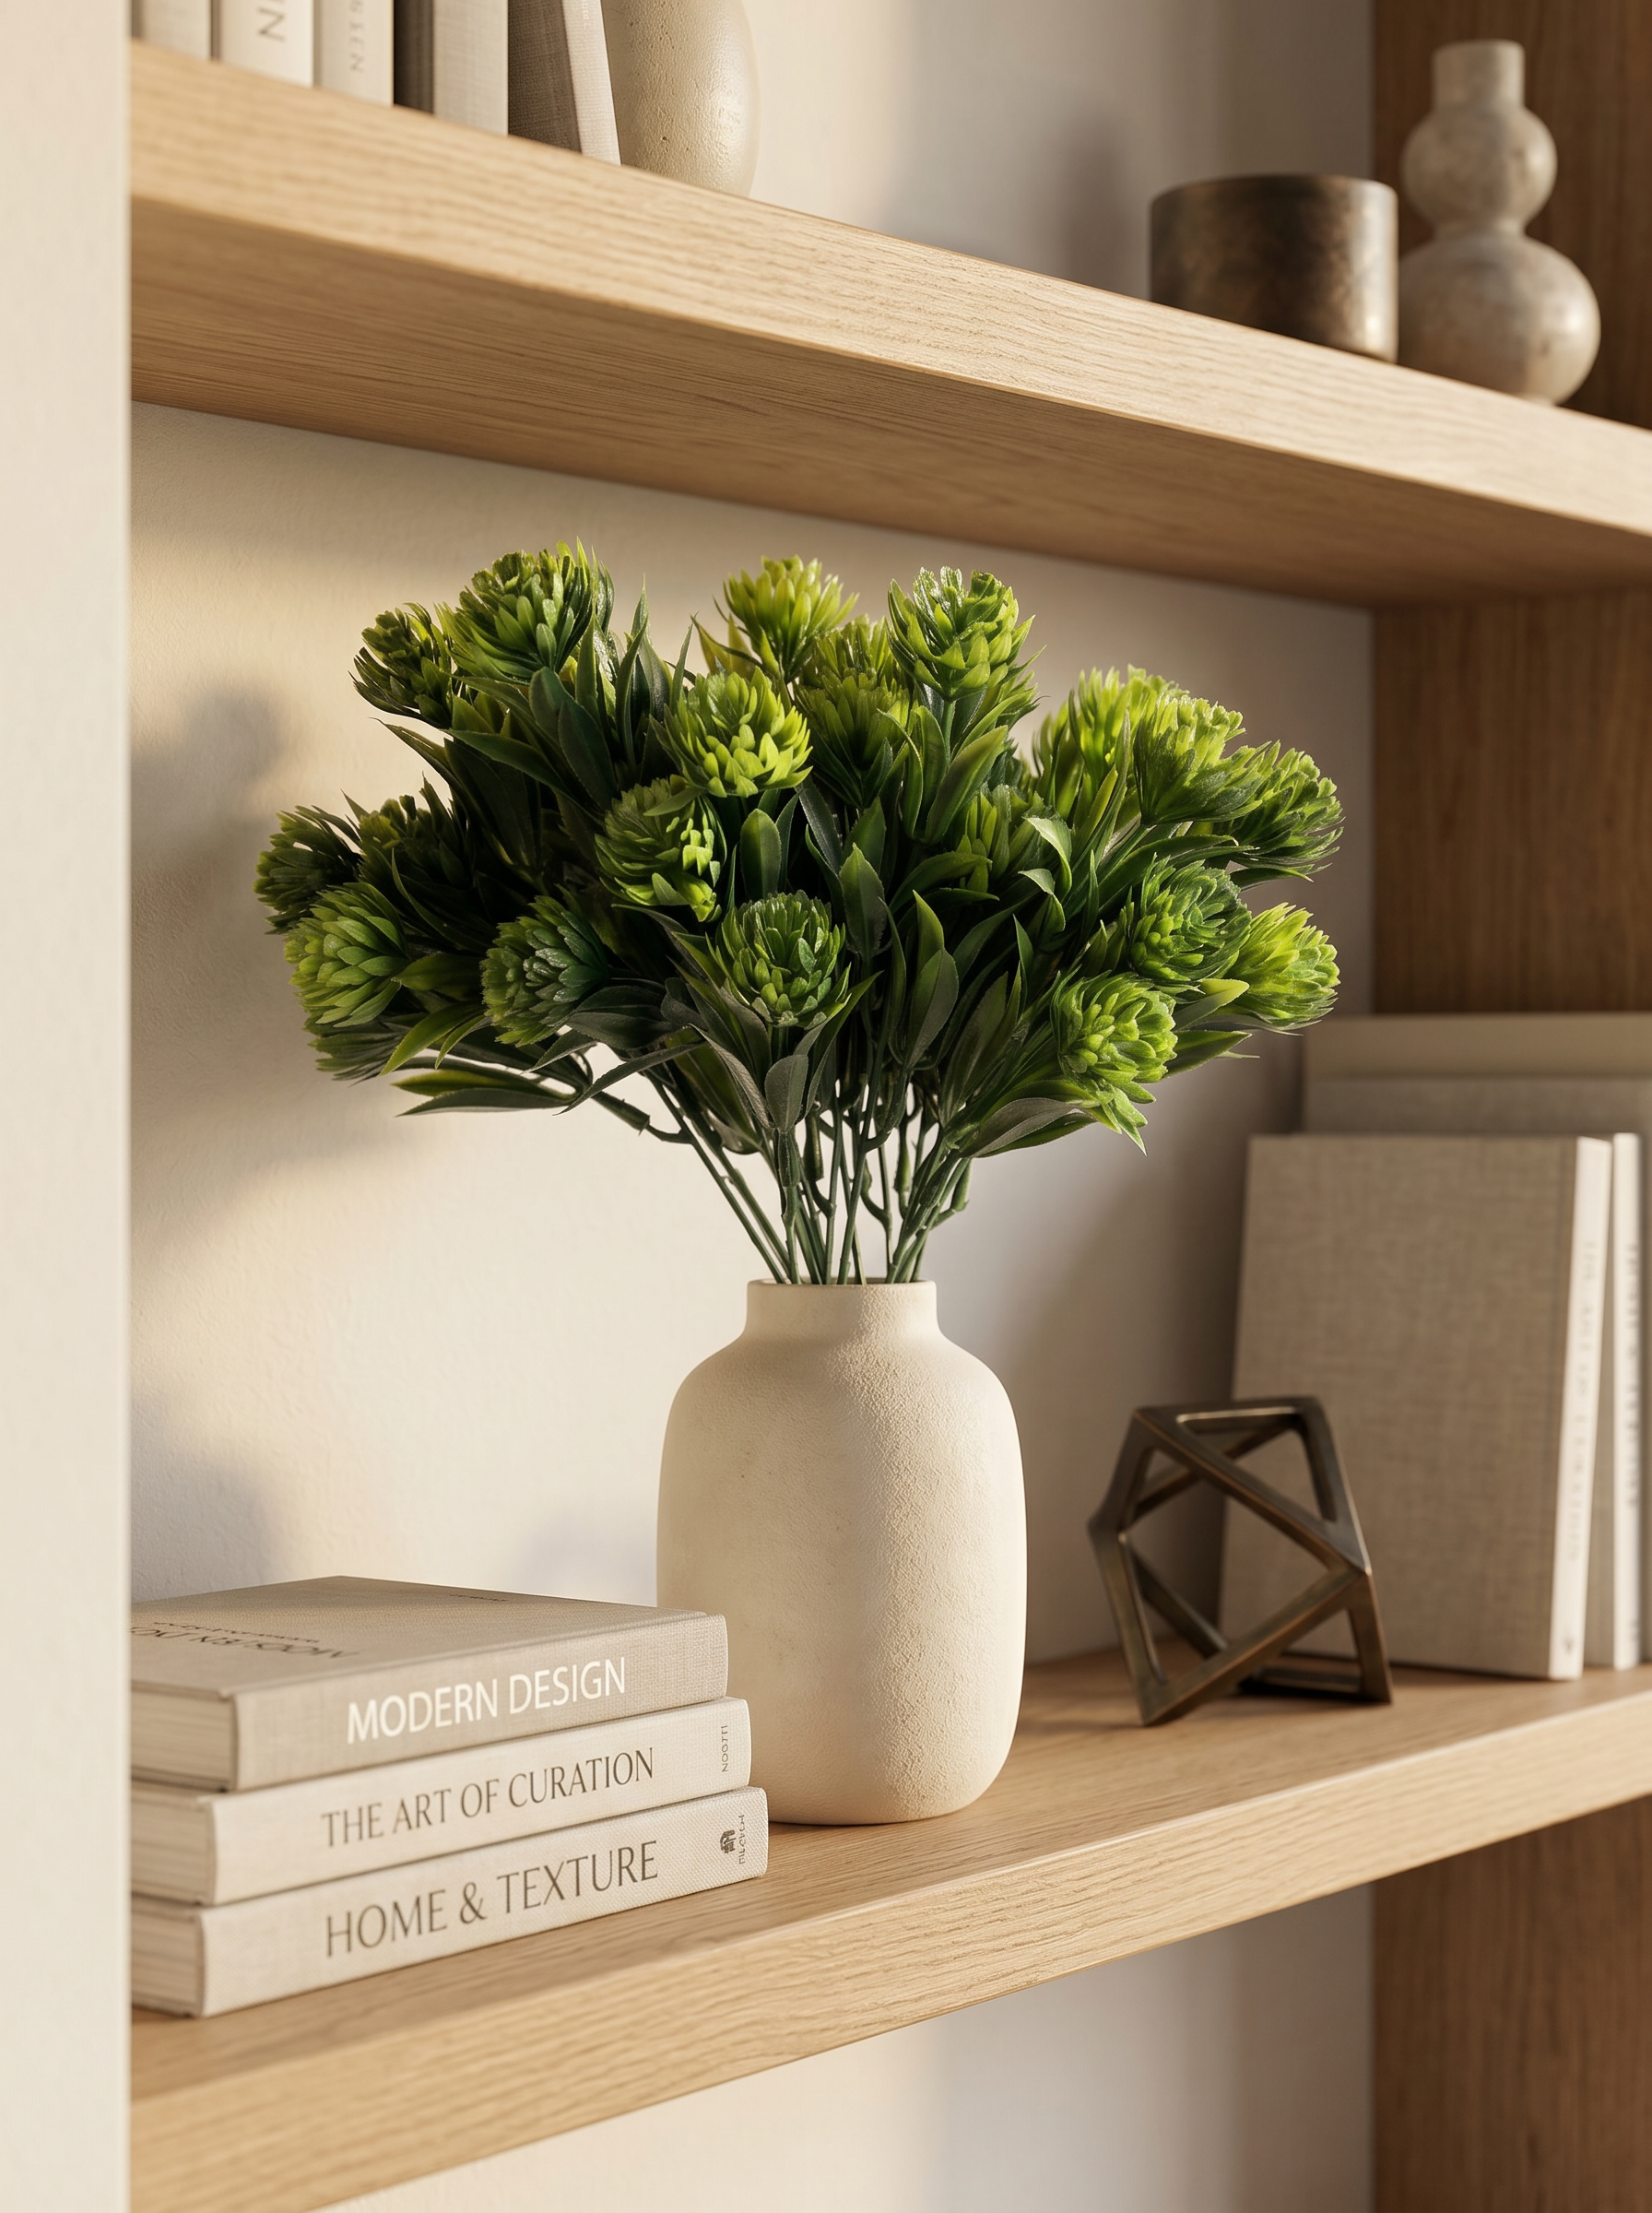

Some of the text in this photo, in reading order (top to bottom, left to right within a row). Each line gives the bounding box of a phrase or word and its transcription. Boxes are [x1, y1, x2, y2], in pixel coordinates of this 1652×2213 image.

[348, 1657, 625, 1745] MODERN DESIGN
[322, 1746, 654, 1848] THE ART OF CURATION
[327, 1840, 659, 1959] HOME & TEXTURE
